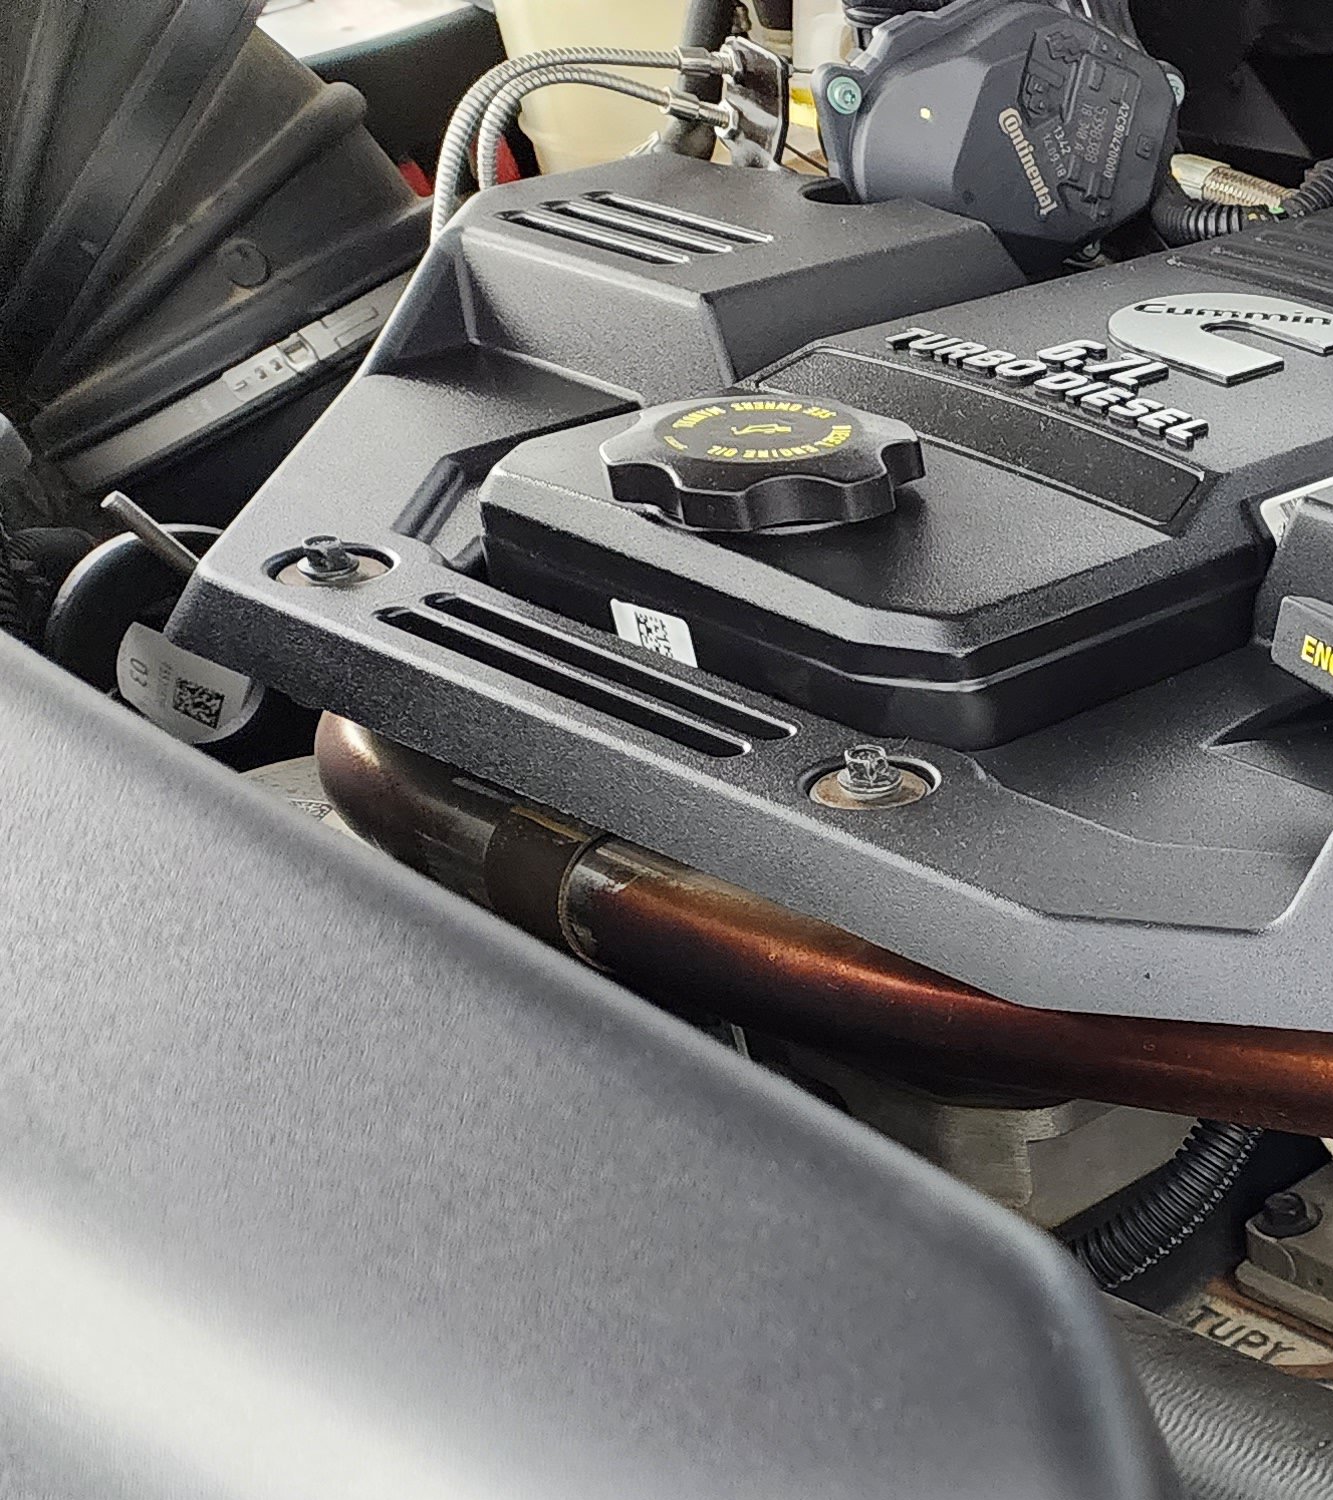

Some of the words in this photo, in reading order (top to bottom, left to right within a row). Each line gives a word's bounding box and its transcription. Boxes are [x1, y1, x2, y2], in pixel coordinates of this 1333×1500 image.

[998, 107, 1058, 217] Continental
[885, 326, 1049, 387] TURBO
[1034, 371, 1209, 450] DIESEL
[1036, 339, 1170, 393] 6.7L
[1185, 1303, 1297, 1364] TUPY
